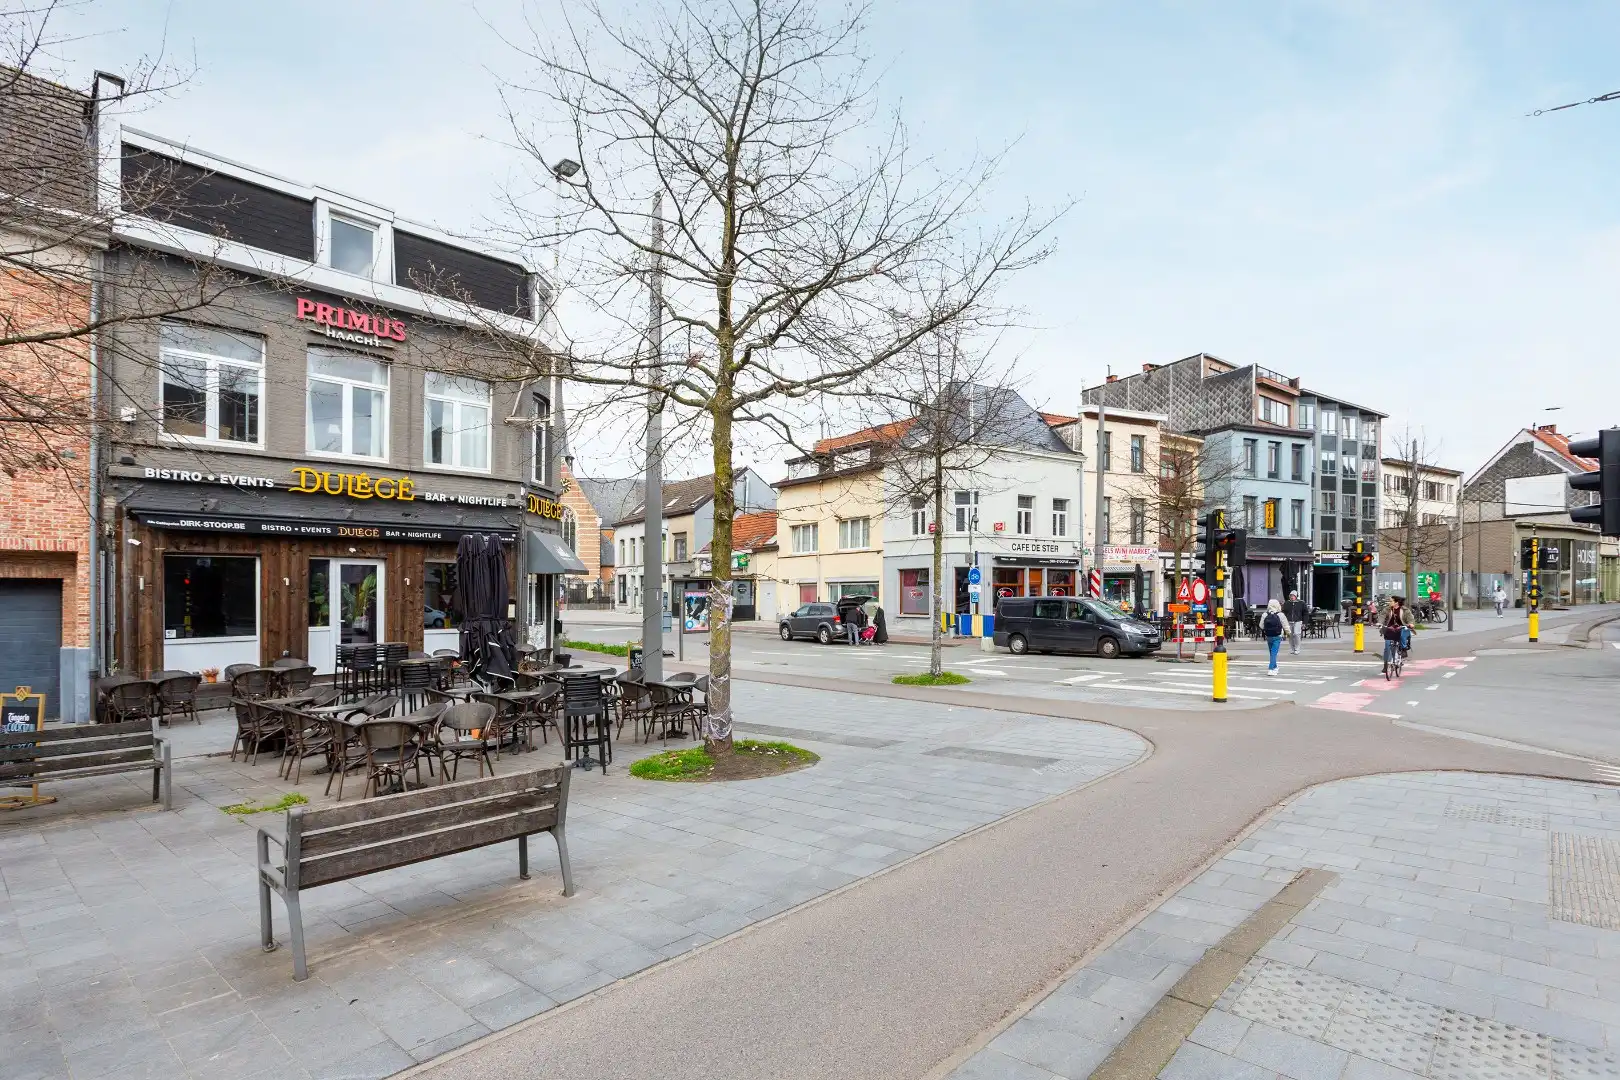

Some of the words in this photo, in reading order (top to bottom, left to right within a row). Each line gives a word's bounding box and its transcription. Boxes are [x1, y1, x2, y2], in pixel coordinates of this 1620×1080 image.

[296, 297, 406, 342] PRIMUS
[326, 328, 382, 347] HAACHT
[144, 467, 202, 481] BISTRO
[220, 474, 275, 488] EVENTS
[425, 492, 446, 502] BAR
[458, 495, 507, 507] NIGHTLIFE
[180, 519, 246, 530] DIRK-STOOP.BE
[261, 524, 292, 532] BISTRO
[301, 526, 331, 534] EVENTS
[407, 531, 442, 539] NIGHTLIFE
[1011, 543, 1030, 551] CAFE
[1031, 544, 1041, 552] DE
